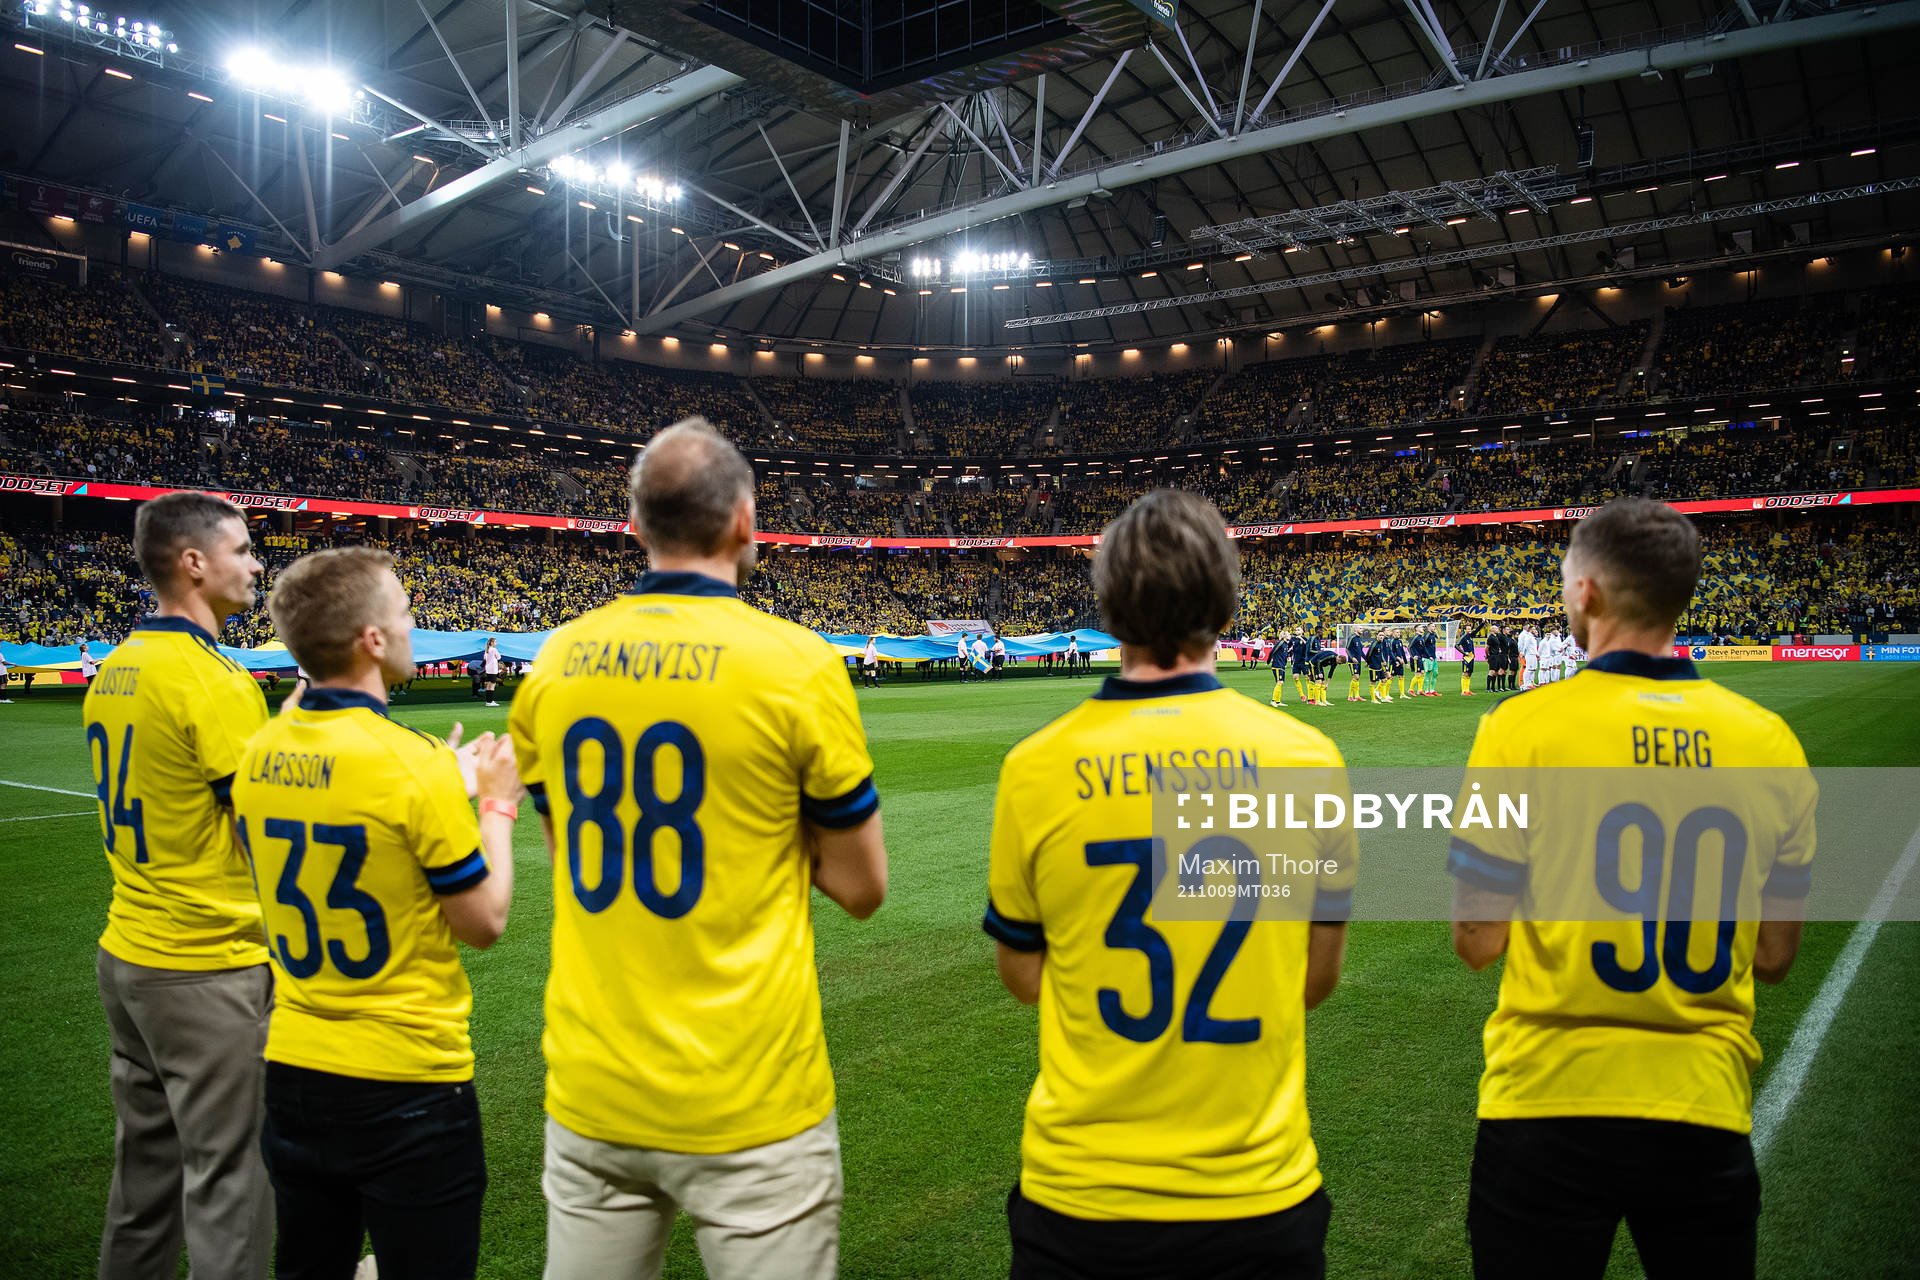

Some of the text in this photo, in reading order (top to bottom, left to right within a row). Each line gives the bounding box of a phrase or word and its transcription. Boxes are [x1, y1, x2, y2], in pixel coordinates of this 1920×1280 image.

[128, 211, 157, 227] UEFA
[0, 477, 73, 494] DDSET
[228, 493, 296, 509] ODDSET
[1765, 493, 1838, 508] ODDSET
[419, 507, 475, 521] ODDSET
[1389, 515, 1445, 529] ODDSET
[576, 519, 622, 531] ODDSET
[1235, 525, 1284, 536] ODDSET
[819, 536, 864, 545] ODDSET
[957, 537, 1005, 547] ODDSET
[563, 641, 725, 681] GRANQVIST
[1730, 649, 1768, 658] Perryman
[1782, 648, 1850, 660] merresor
[94, 666, 140, 697] LUSTIG
[1632, 725, 1713, 768] BERG
[249, 750, 336, 790] LARSSON
[1075, 747, 1260, 801] SVENSSON
[562, 715, 707, 920] 88
[1591, 802, 1748, 995] 90
[1083, 833, 1262, 1043] 32
